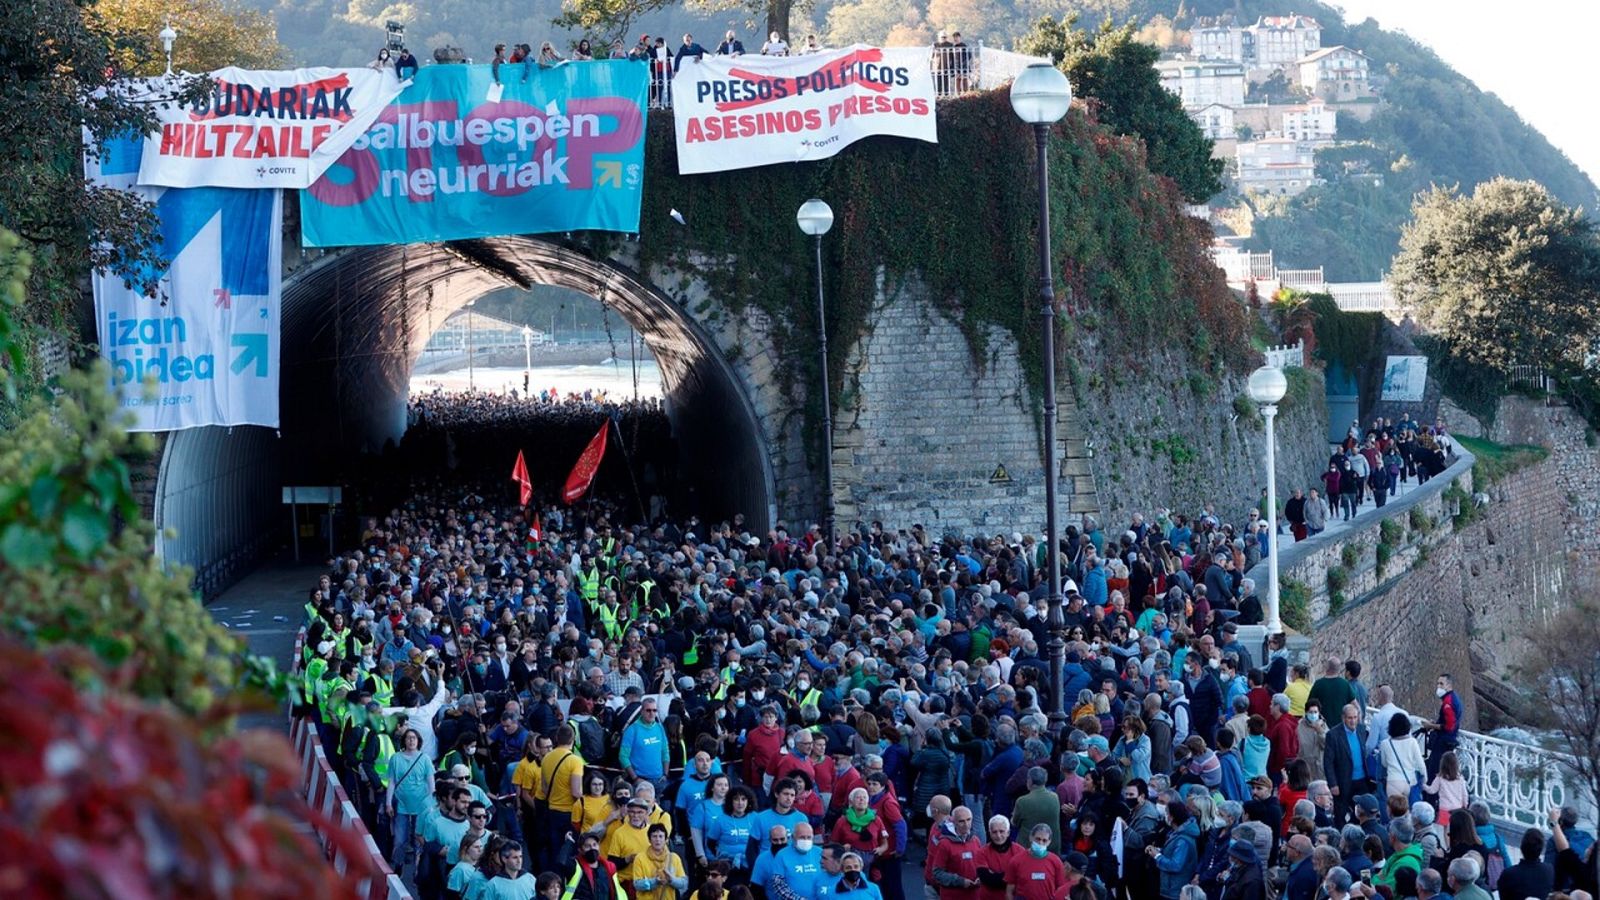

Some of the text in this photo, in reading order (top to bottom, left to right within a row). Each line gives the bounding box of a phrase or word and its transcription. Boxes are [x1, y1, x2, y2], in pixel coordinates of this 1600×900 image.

[697, 61, 909, 103] PRESOS POLÍTICOS
[685, 94, 930, 144] ASESINOS PRESOS
[159, 122, 345, 159] HILTZAILE
[269, 167, 296, 175] COVITE
[381, 147, 571, 198] neurriak
[108, 311, 186, 347] izan
[111, 347, 214, 386] bidea
